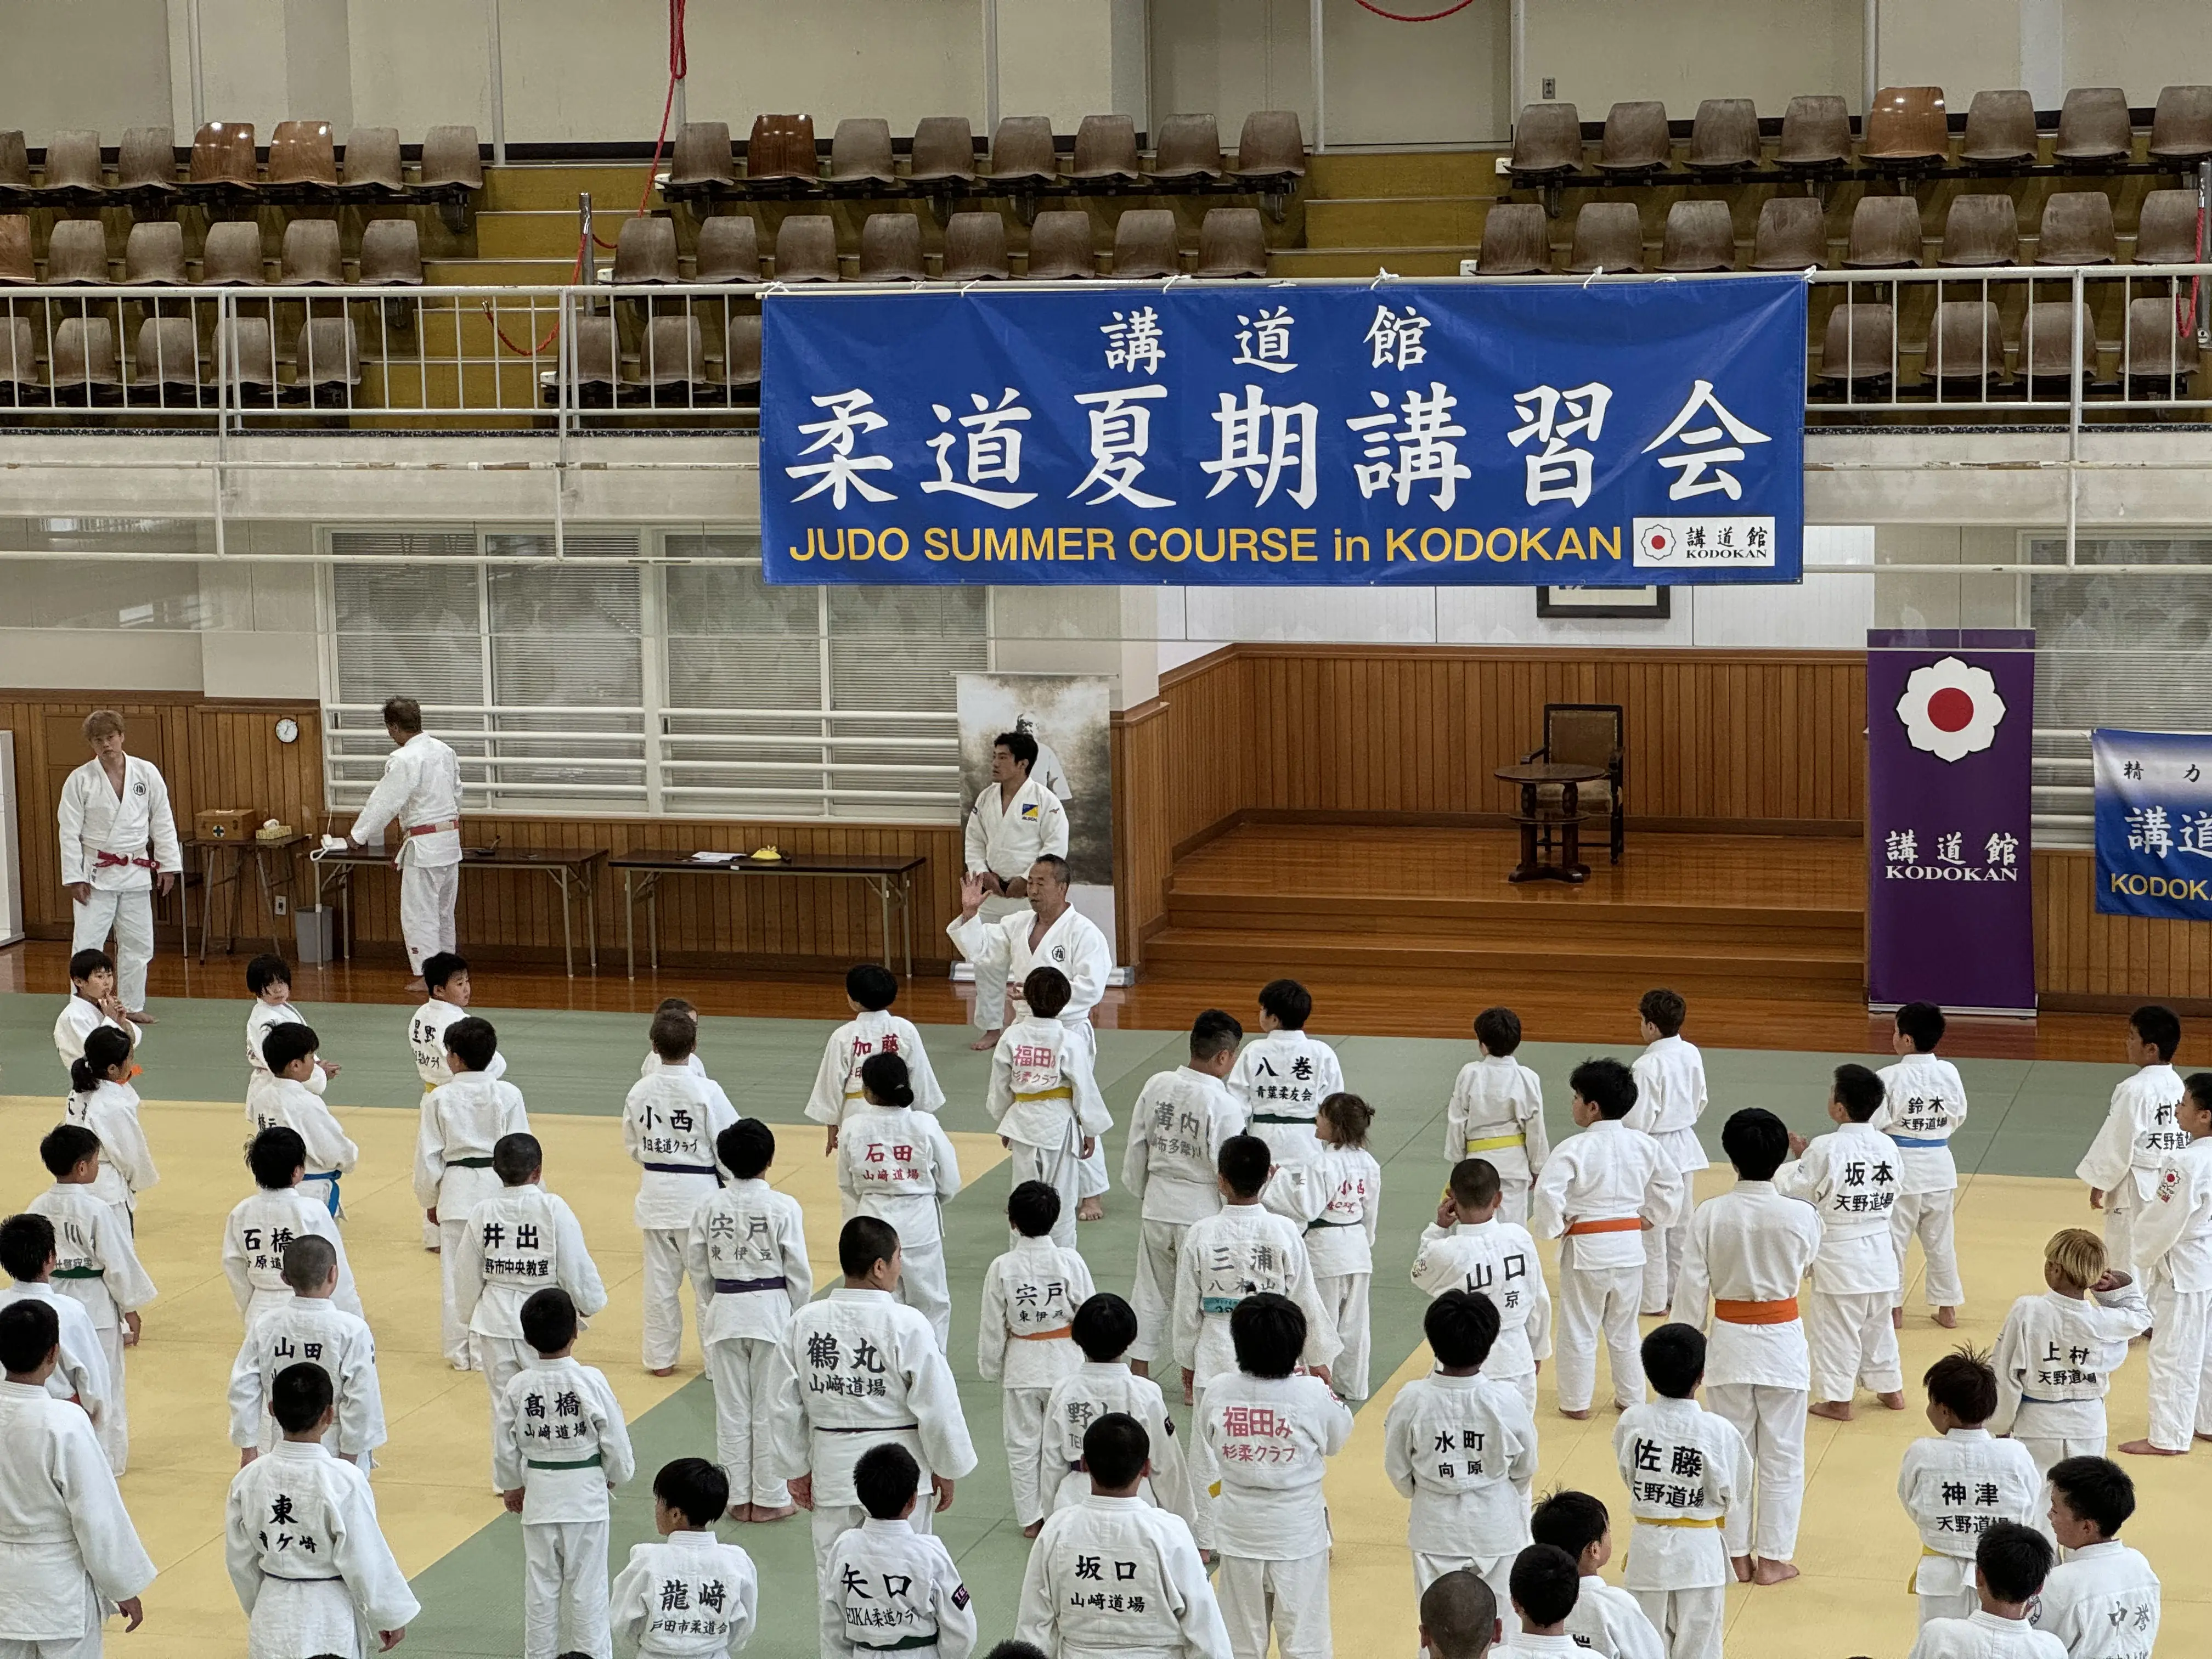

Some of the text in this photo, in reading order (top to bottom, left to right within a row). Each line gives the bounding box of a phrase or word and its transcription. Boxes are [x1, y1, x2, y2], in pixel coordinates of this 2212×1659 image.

[1101, 306, 1430, 374] 講道館
[786, 380, 1771, 510] 柔道夏期講習会
[791, 528, 1621, 562] JUDO SUMMER COURSE in KODOKAN
[1686, 526, 1768, 549] 講道館
[1686, 549, 1767, 559] KODOKAN
[1885, 829, 2019, 866] 講道館
[1885, 865, 2019, 882] KODOKAN
[2111, 872, 2212, 901] KODOK
[1255, 1056, 1314, 1081] 八巻
[639, 1104, 694, 1133] 小西
[1908, 1096, 1945, 1114] 鈴木
[1901, 1116, 1948, 1131] 天野道場
[864, 1143, 913, 1163] 石田
[1844, 1160, 1894, 1187] 坂本
[483, 1223, 539, 1250] 井出
[709, 1212, 769, 1242] 宍戸
[1210, 1245, 1273, 1273] 三浦
[1466, 1254, 1526, 1294] 山口
[1015, 1282, 1064, 1307] 宍戸
[274, 1336, 324, 1361] 山田
[806, 1331, 887, 1374] 鶴丸
[2042, 1341, 2090, 1365] 上村
[1222, 1406, 1293, 1438] 福田み
[1435, 1430, 1485, 1453] 水町
[1438, 1459, 1483, 1478] 向原
[1635, 1437, 1703, 1477] 佐藤
[1942, 1481, 2000, 1506] 神津
[268, 1493, 299, 1525] 東
[840, 1562, 912, 1599] 矢口
[1075, 1554, 1137, 1582] 坂口
